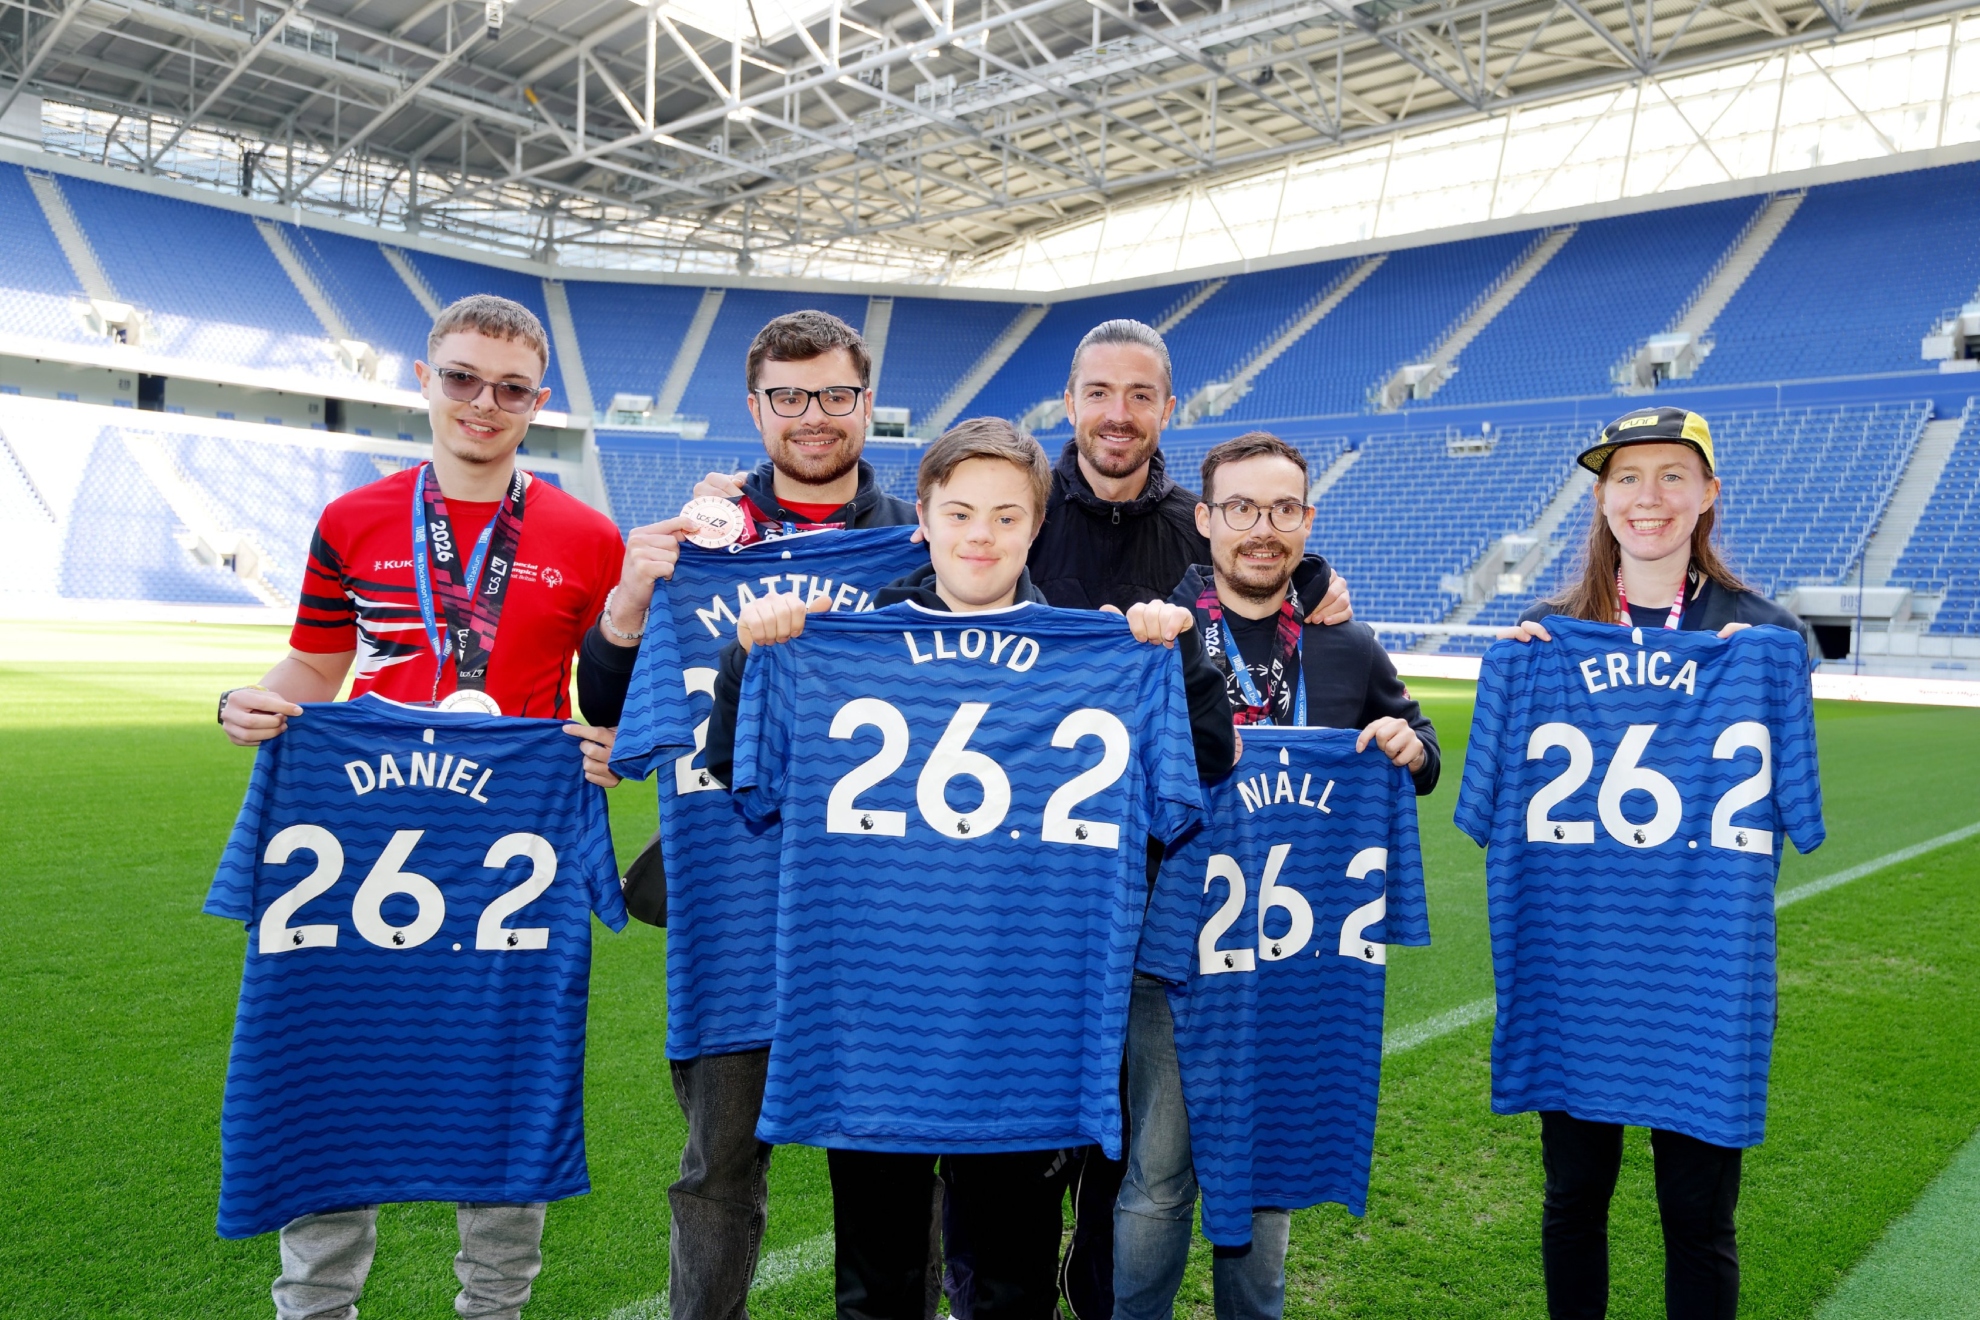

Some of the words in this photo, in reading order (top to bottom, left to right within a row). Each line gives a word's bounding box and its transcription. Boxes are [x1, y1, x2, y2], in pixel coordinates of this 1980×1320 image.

[417, 552, 425, 563] Hill
[430, 520, 454, 562] 2026
[384, 559, 414, 569] KUK
[417, 564, 428, 598] Dickinson
[466, 554, 482, 583] Stadium
[485, 575, 501, 595] tcs
[513, 561, 539, 570] pecial
[423, 598, 432, 627] Stadium
[903, 628, 1040, 672] LLOYD
[1205, 622, 1221, 657] 2026
[1579, 651, 1698, 695] ERICA
[344, 752, 494, 803] DANIEL
[826, 697, 1130, 849] 26.2
[1237, 771, 1335, 814] NIALL
[1526, 721, 1773, 855] 26.2
[259, 824, 558, 954] 26.2
[1199, 843, 1388, 975] 26.2
